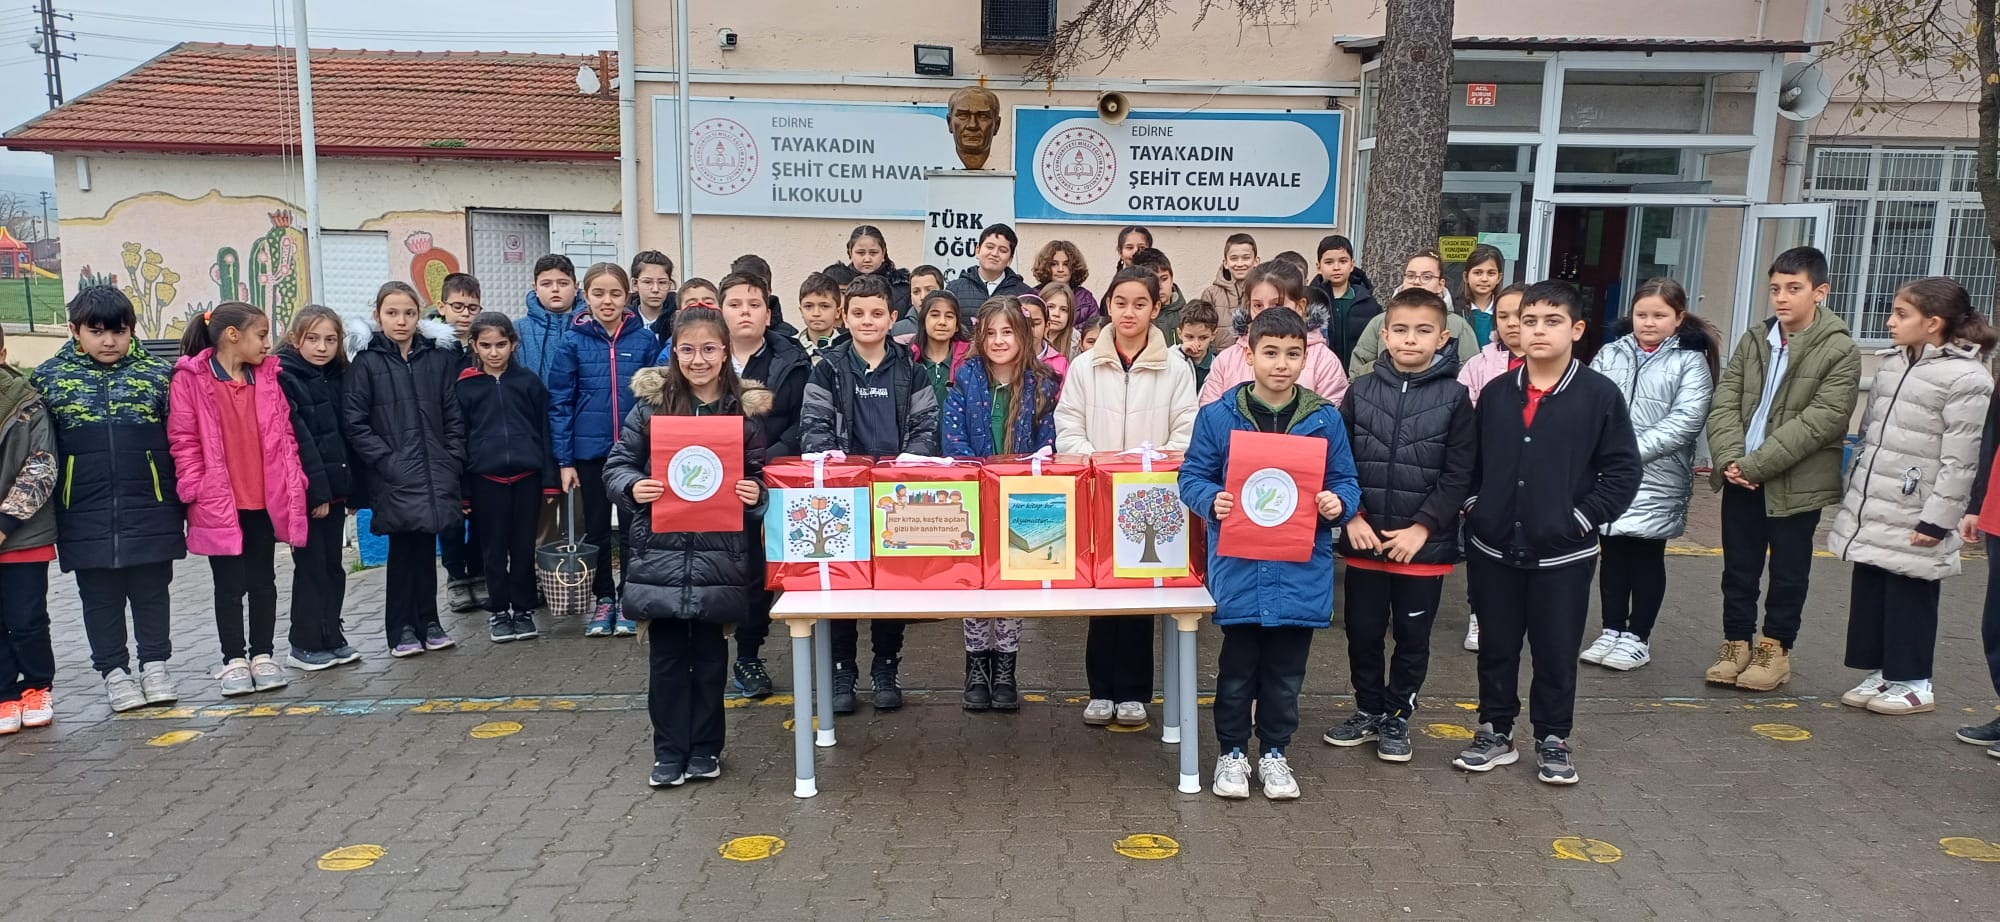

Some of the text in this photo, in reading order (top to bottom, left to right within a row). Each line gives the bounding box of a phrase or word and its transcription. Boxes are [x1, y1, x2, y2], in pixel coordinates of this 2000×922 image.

[1470, 97, 1492, 105] 112
[771, 116, 814, 129] EDİRNE
[1131, 124, 1174, 137] EDİRNE
[771, 136, 875, 154] TAYAKADIN
[1129, 145, 1234, 162] TAYAKADIN
[771, 160, 943, 181] ŞEHİT CEM HAVAL
[1129, 168, 1302, 189] ŞEHİT CEM HAVALE
[772, 184, 863, 204] İLKOKULU
[1128, 195, 1240, 212] ORTAOKULU
[929, 208, 984, 230] TÜRK
[934, 236, 978, 258] ÖĞÜ
[1025, 502, 1043, 510] kitap
